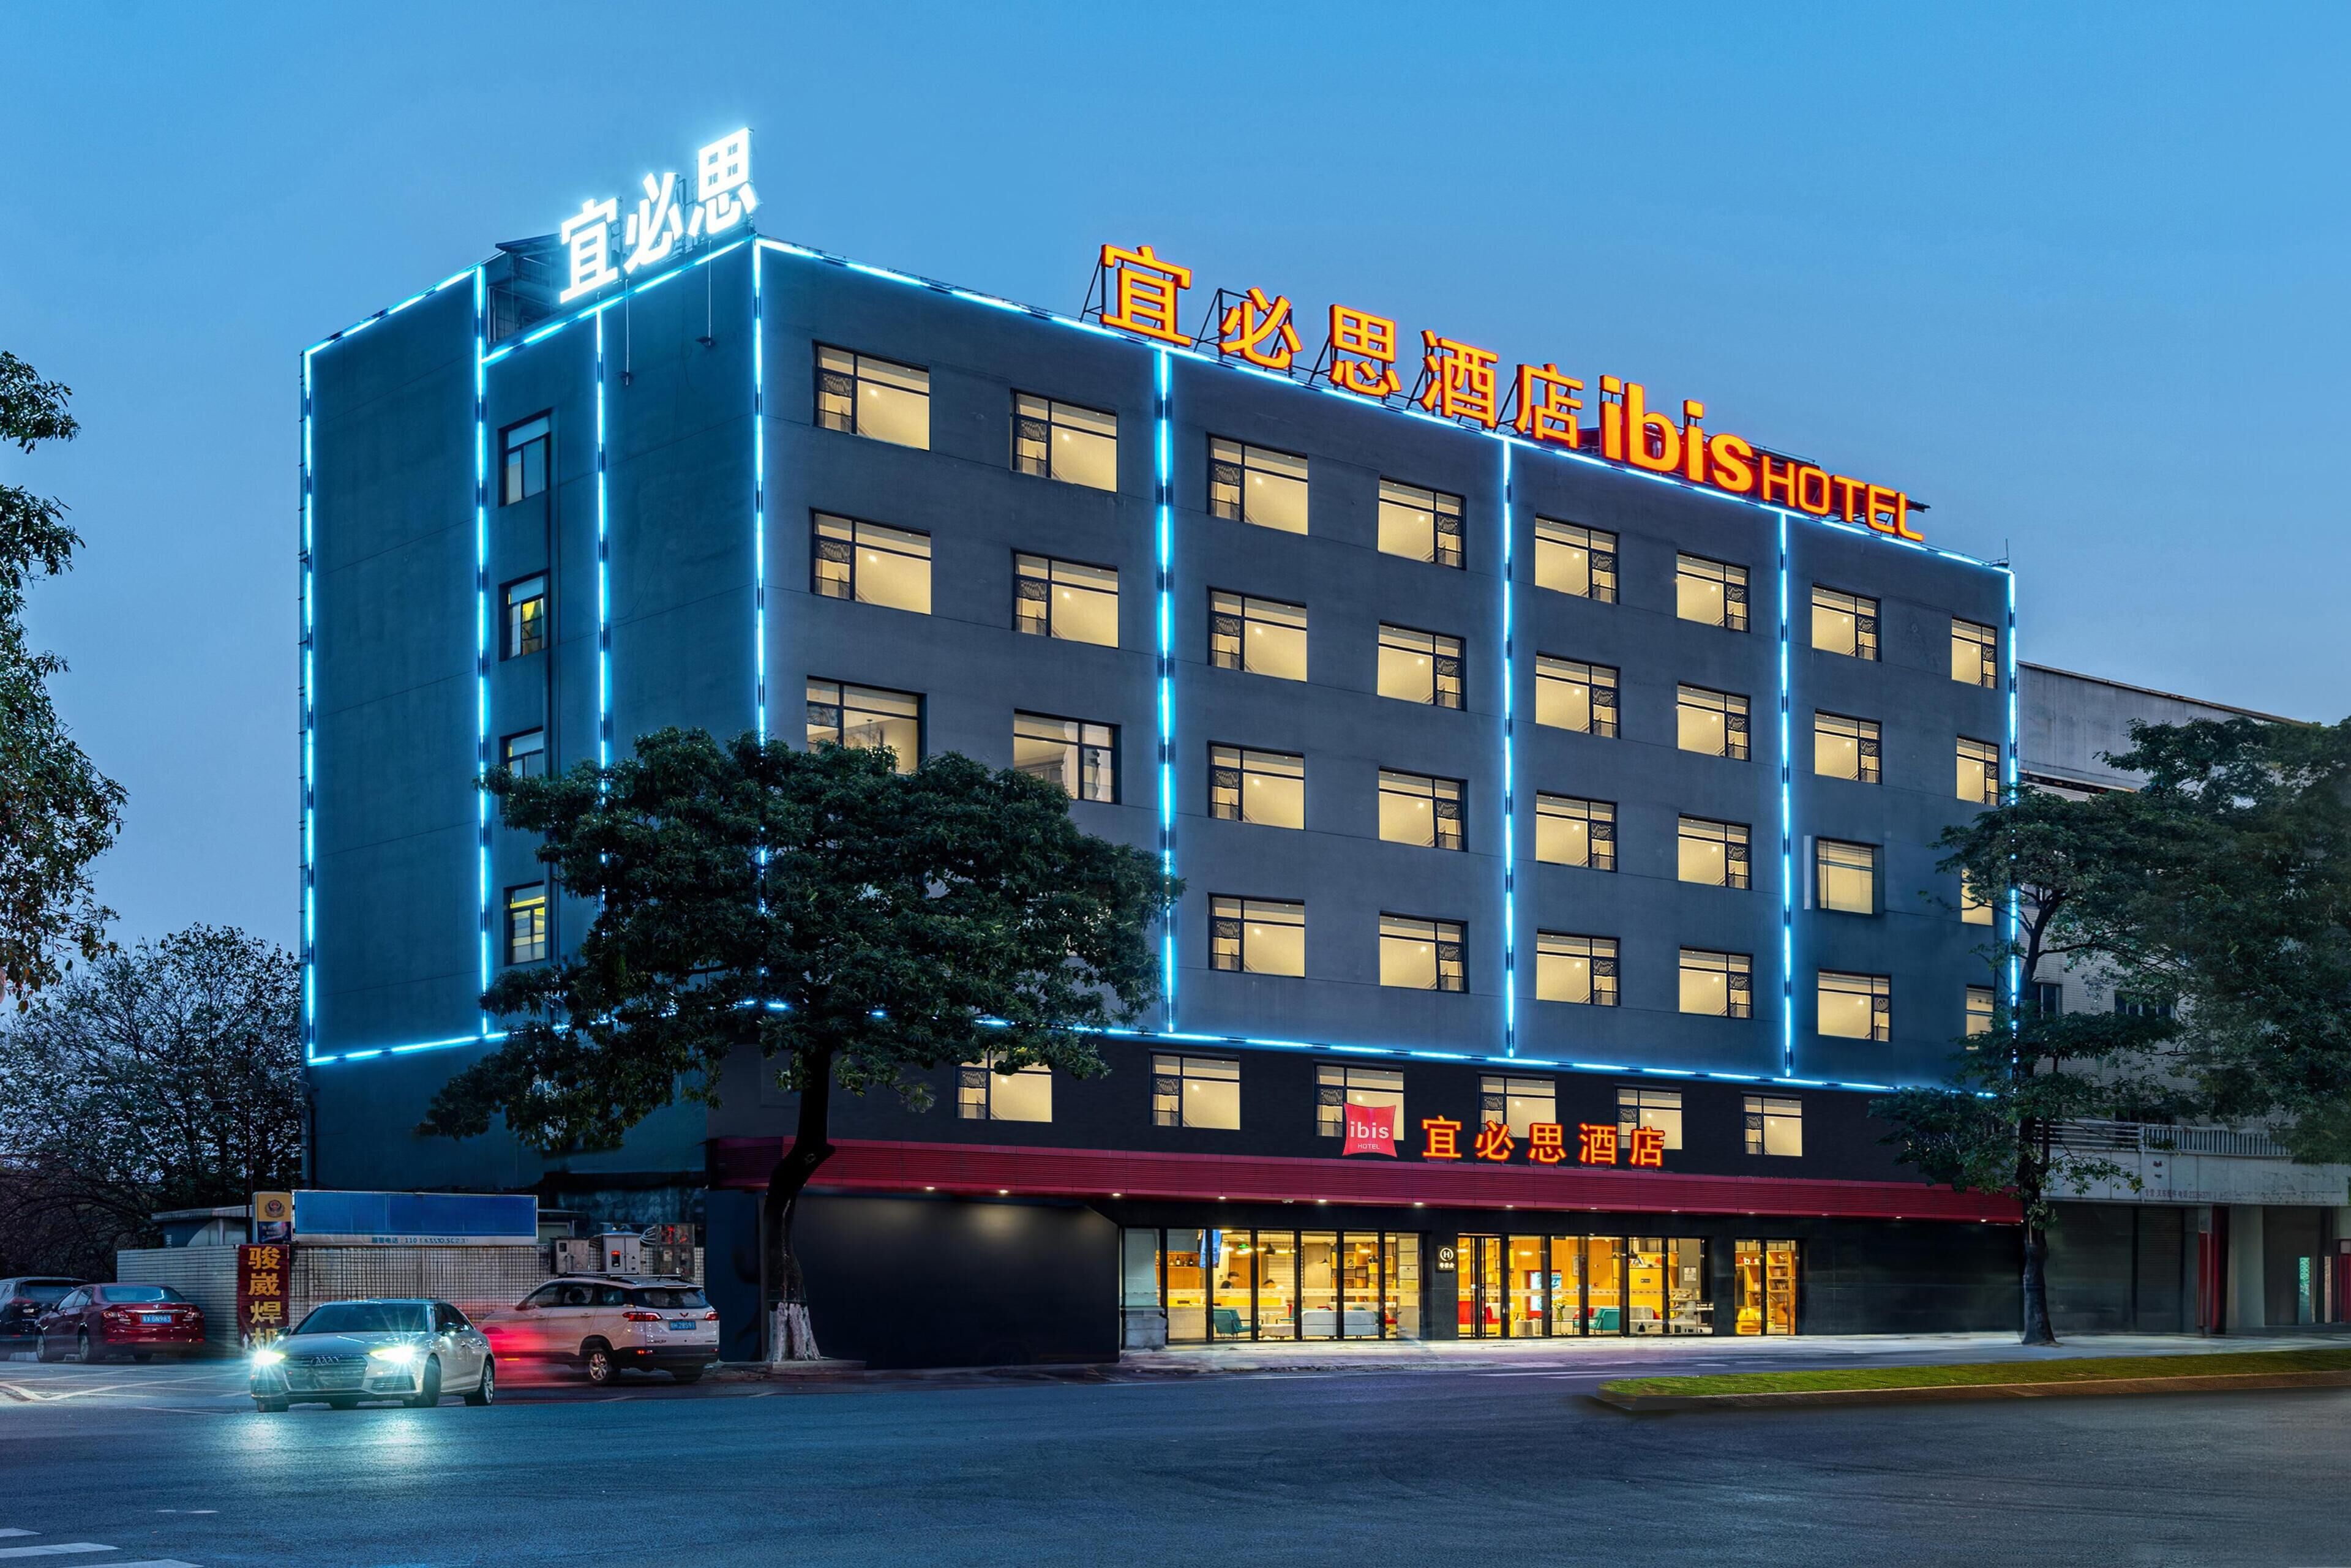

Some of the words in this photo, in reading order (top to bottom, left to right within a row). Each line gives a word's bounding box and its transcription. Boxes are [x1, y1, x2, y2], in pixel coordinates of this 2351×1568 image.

[560, 127, 757, 304] 宜必思
[1102, 244, 1584, 449] 宜必思酒店
[1600, 375, 1755, 493] ibis
[1759, 454, 1924, 542] HOTEL
[1350, 1121, 1389, 1139] ibis
[1422, 1114, 1667, 1167] 宜必思酒店
